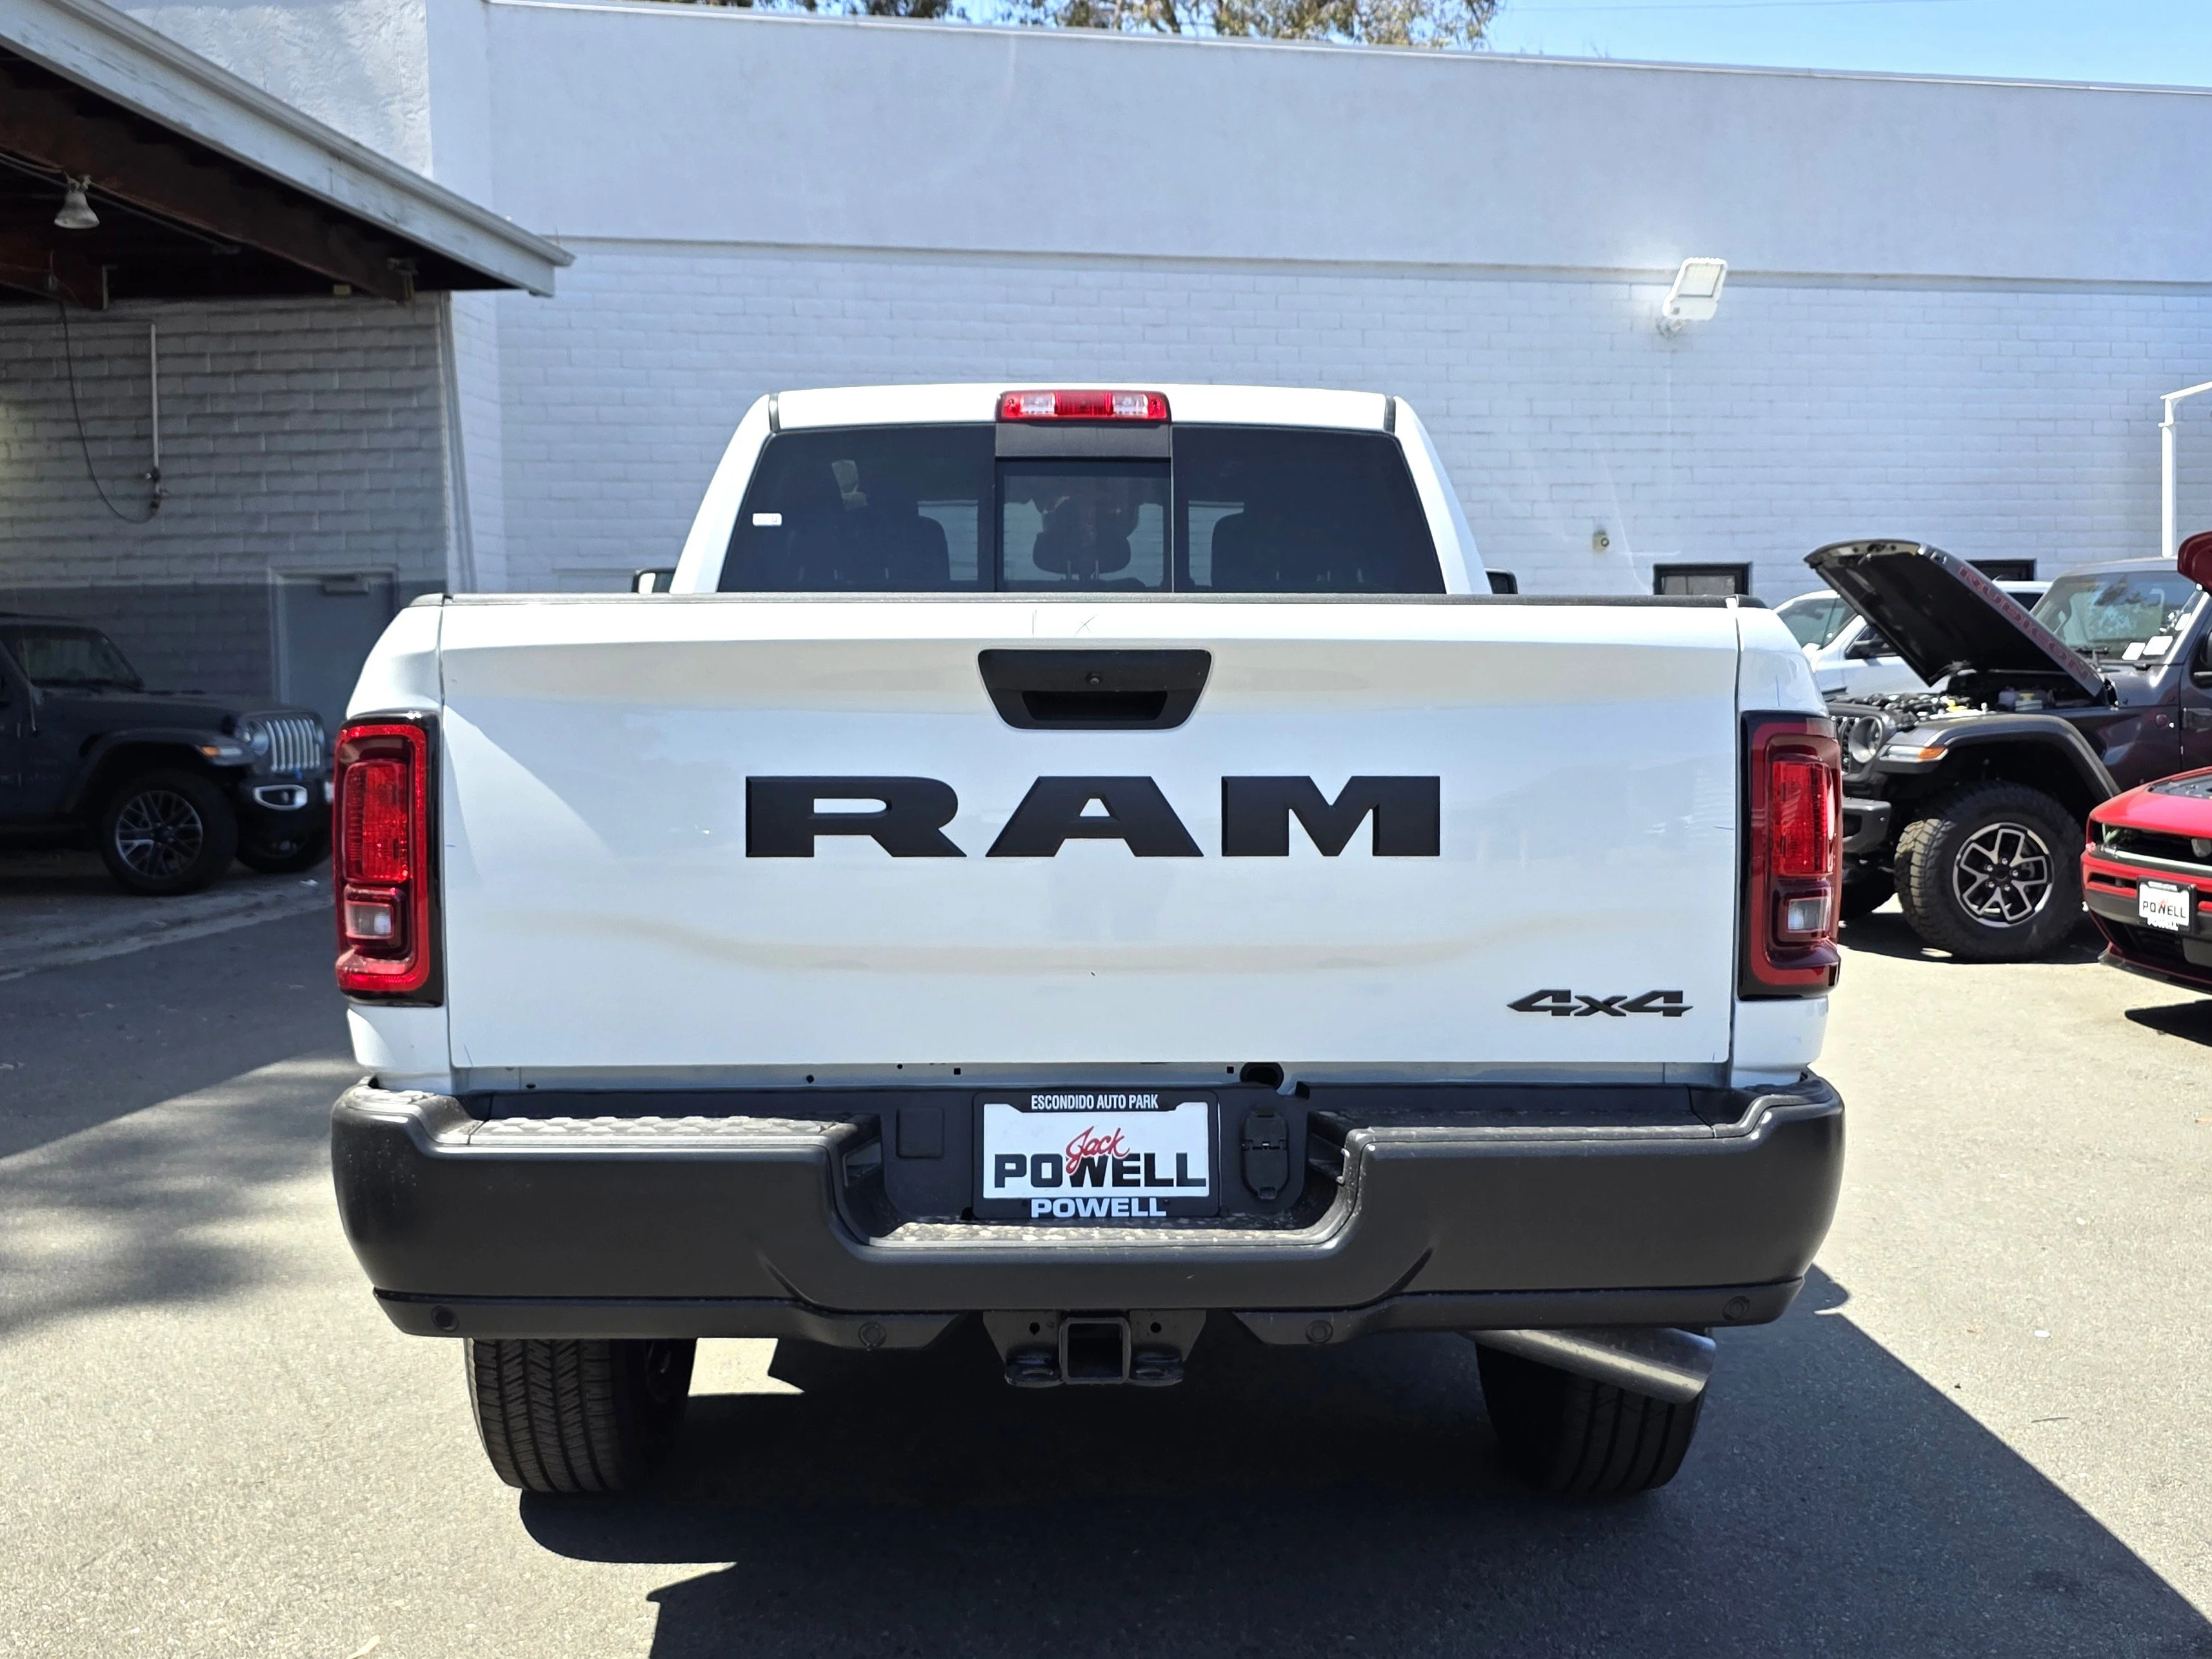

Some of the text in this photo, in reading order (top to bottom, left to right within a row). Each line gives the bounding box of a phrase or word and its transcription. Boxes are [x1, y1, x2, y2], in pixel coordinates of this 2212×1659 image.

[1958, 565, 2091, 682] RUBICON
[745, 776, 1440, 858] RAM
[1506, 989, 1694, 1017] 4x4
[1031, 1094, 1159, 1110] ESCONDIDO AUTO PARK
[1066, 1125, 1130, 1174] Jack
[994, 1152, 1207, 1188] POWELL
[1031, 1198, 1167, 1218] POWELL
